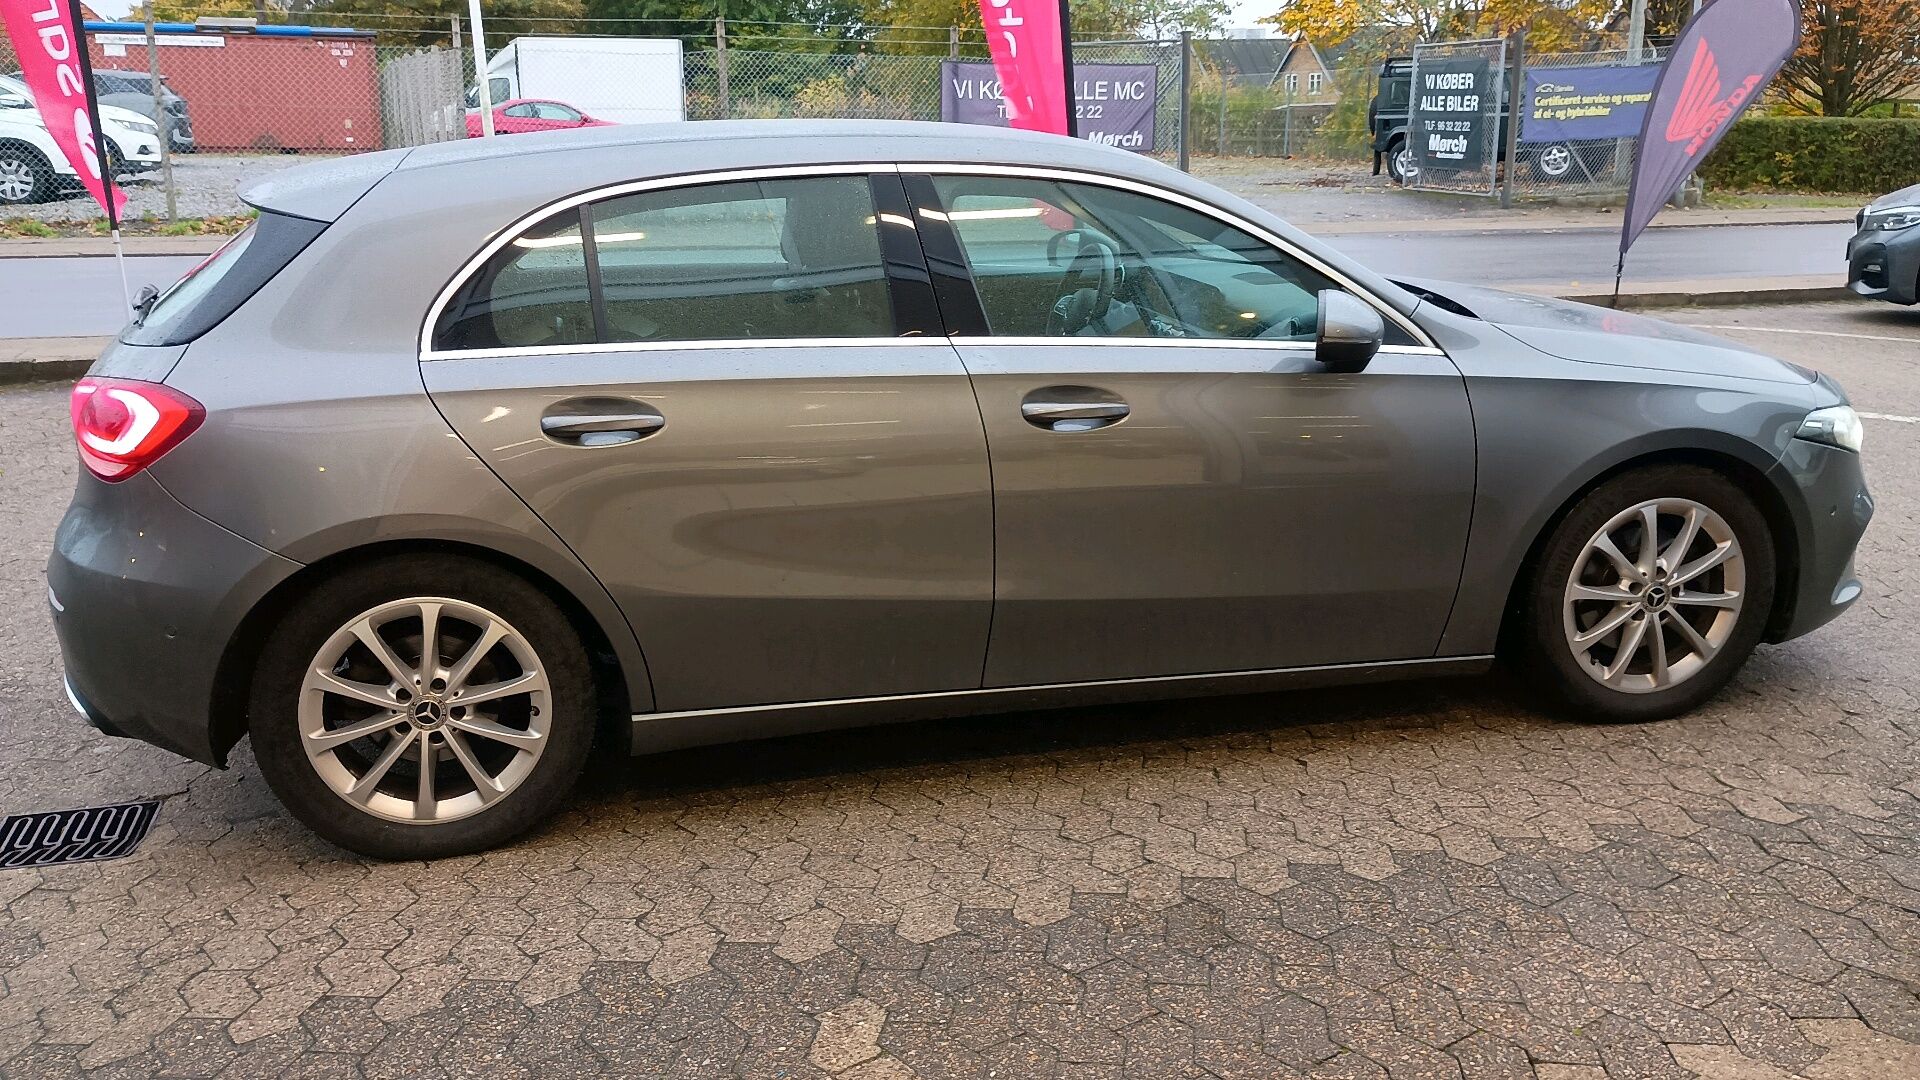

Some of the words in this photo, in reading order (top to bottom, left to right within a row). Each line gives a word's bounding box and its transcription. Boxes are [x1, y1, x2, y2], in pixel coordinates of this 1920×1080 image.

[953, 79, 972, 99] VI
[1074, 81, 1108, 101] LLE
[1114, 81, 1145, 101] MC
[1425, 74, 1435, 90] VI
[1435, 73, 1475, 90] KØBER
[1420, 95, 1446, 112] ALLE
[1446, 95, 1480, 112] BILER
[1535, 95, 1581, 107] Certificeret
[1581, 92, 1611, 105] service
[1611, 94, 1623, 106] og
[1622, 92, 1652, 105] reparat
[1086, 105, 1103, 119] 22
[1533, 109, 1543, 119] af
[1555, 110, 1567, 121] og
[1566, 105, 1612, 119] hybridbiler
[1684, 73, 1763, 157] HONDA
[1437, 120, 1446, 131] 96
[1453, 121, 1462, 132] 22
[1461, 121, 1471, 132] 22
[1088, 130, 1144, 147] Mørch
[1428, 133, 1468, 153] Mørch
